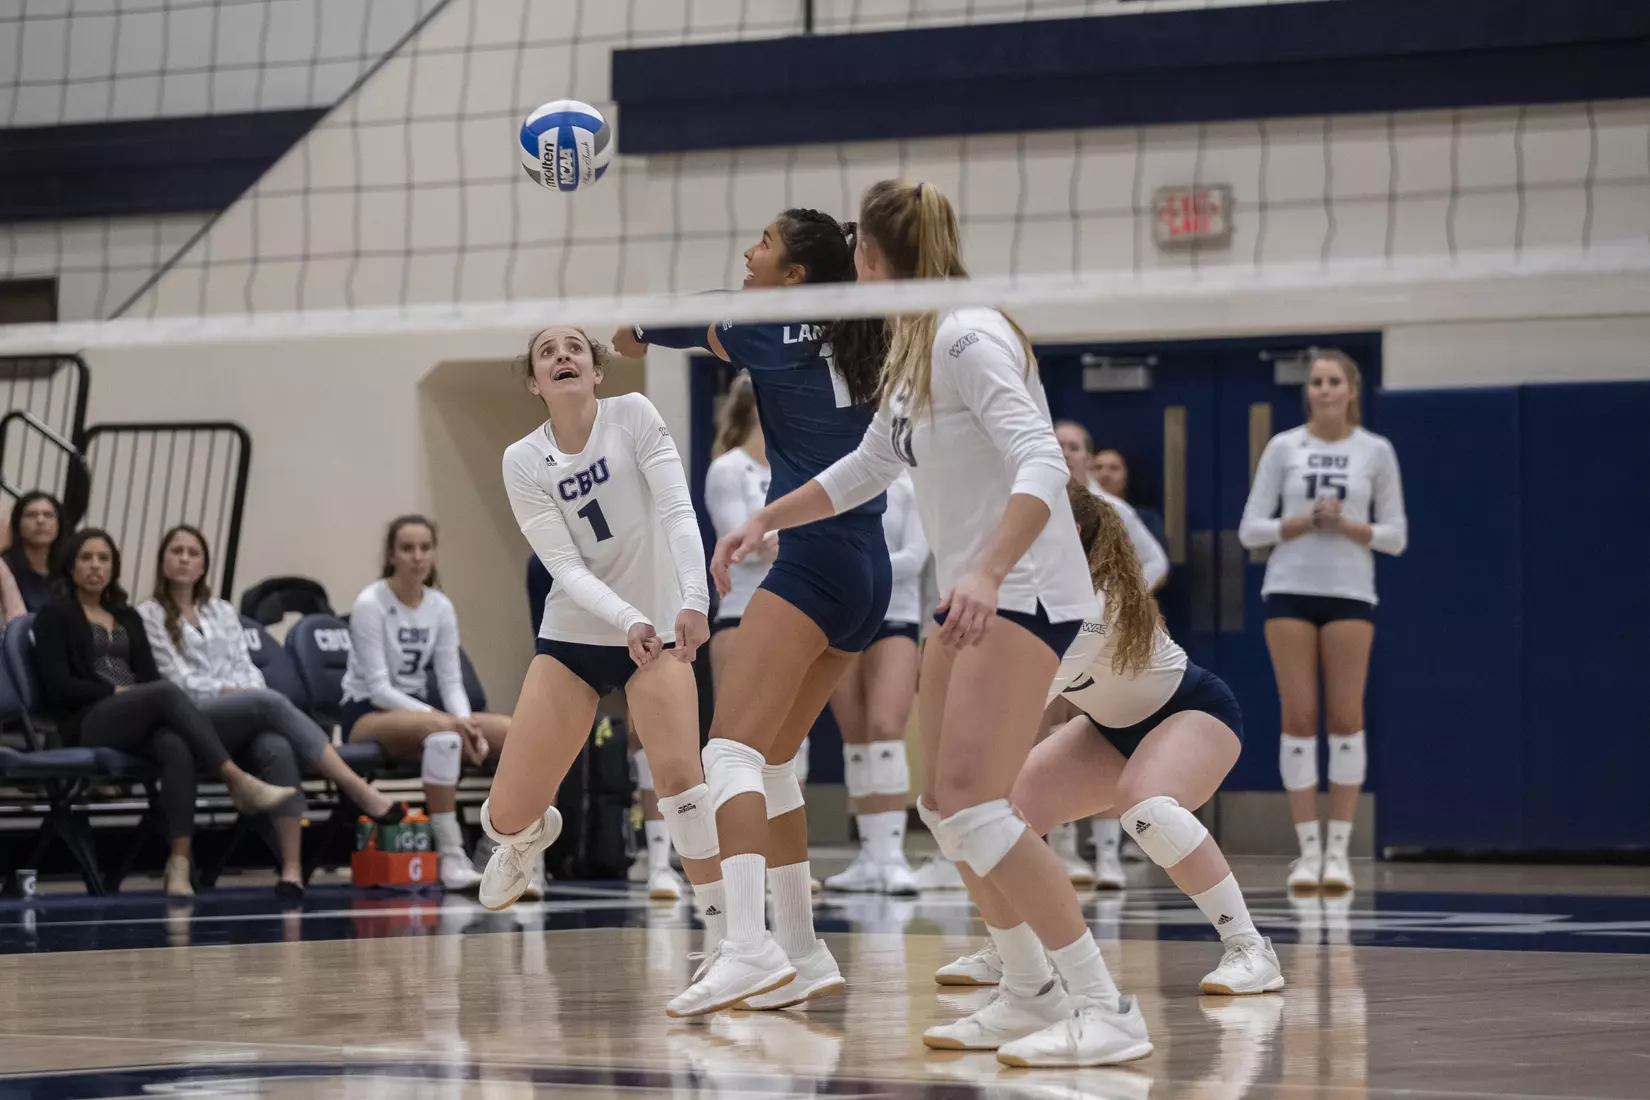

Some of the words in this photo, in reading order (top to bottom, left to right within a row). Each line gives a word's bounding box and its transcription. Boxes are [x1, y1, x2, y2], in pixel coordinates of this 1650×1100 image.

[541, 143, 557, 188] molten
[559, 148, 574, 185] NCAA
[949, 332, 979, 358] WAC
[1307, 454, 1349, 469] CBU
[558, 456, 611, 502] CBU
[1303, 473, 1348, 501] 15
[577, 498, 614, 542] 1
[398, 650, 421, 675] 3
[409, 857, 423, 882] G
